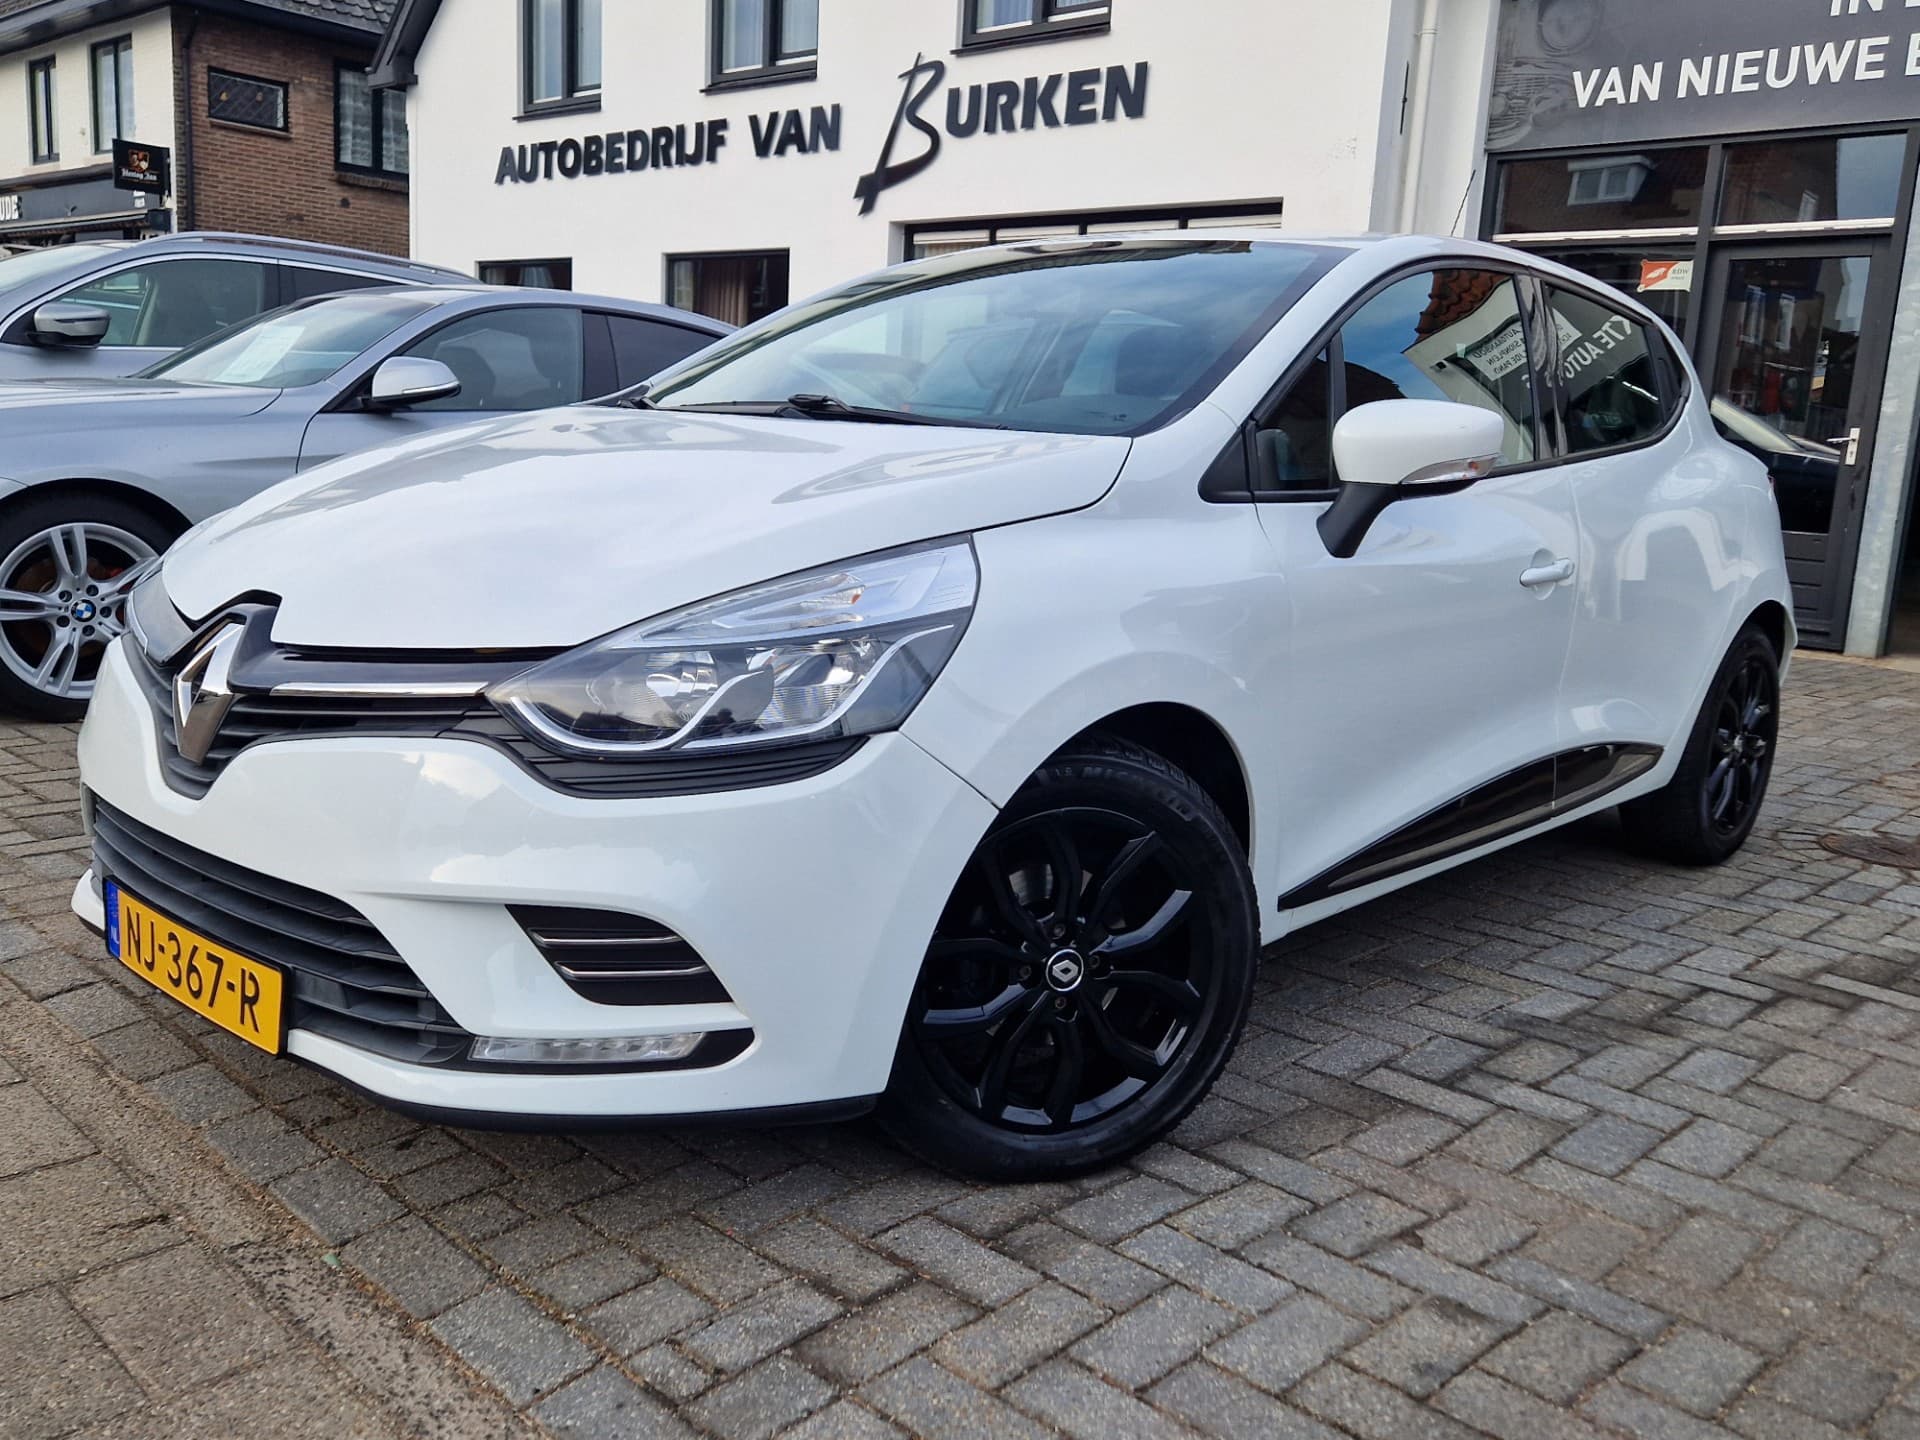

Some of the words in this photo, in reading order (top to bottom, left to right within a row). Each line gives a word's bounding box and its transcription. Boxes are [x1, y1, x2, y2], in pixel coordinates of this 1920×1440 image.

[1572, 62, 1663, 108] VAN
[1677, 36, 1890, 99] NIEUWE
[495, 118, 728, 185] AUTOBEDRIJF
[748, 103, 841, 158] VAN
[126, 905, 260, 1033] NJ-367-R
